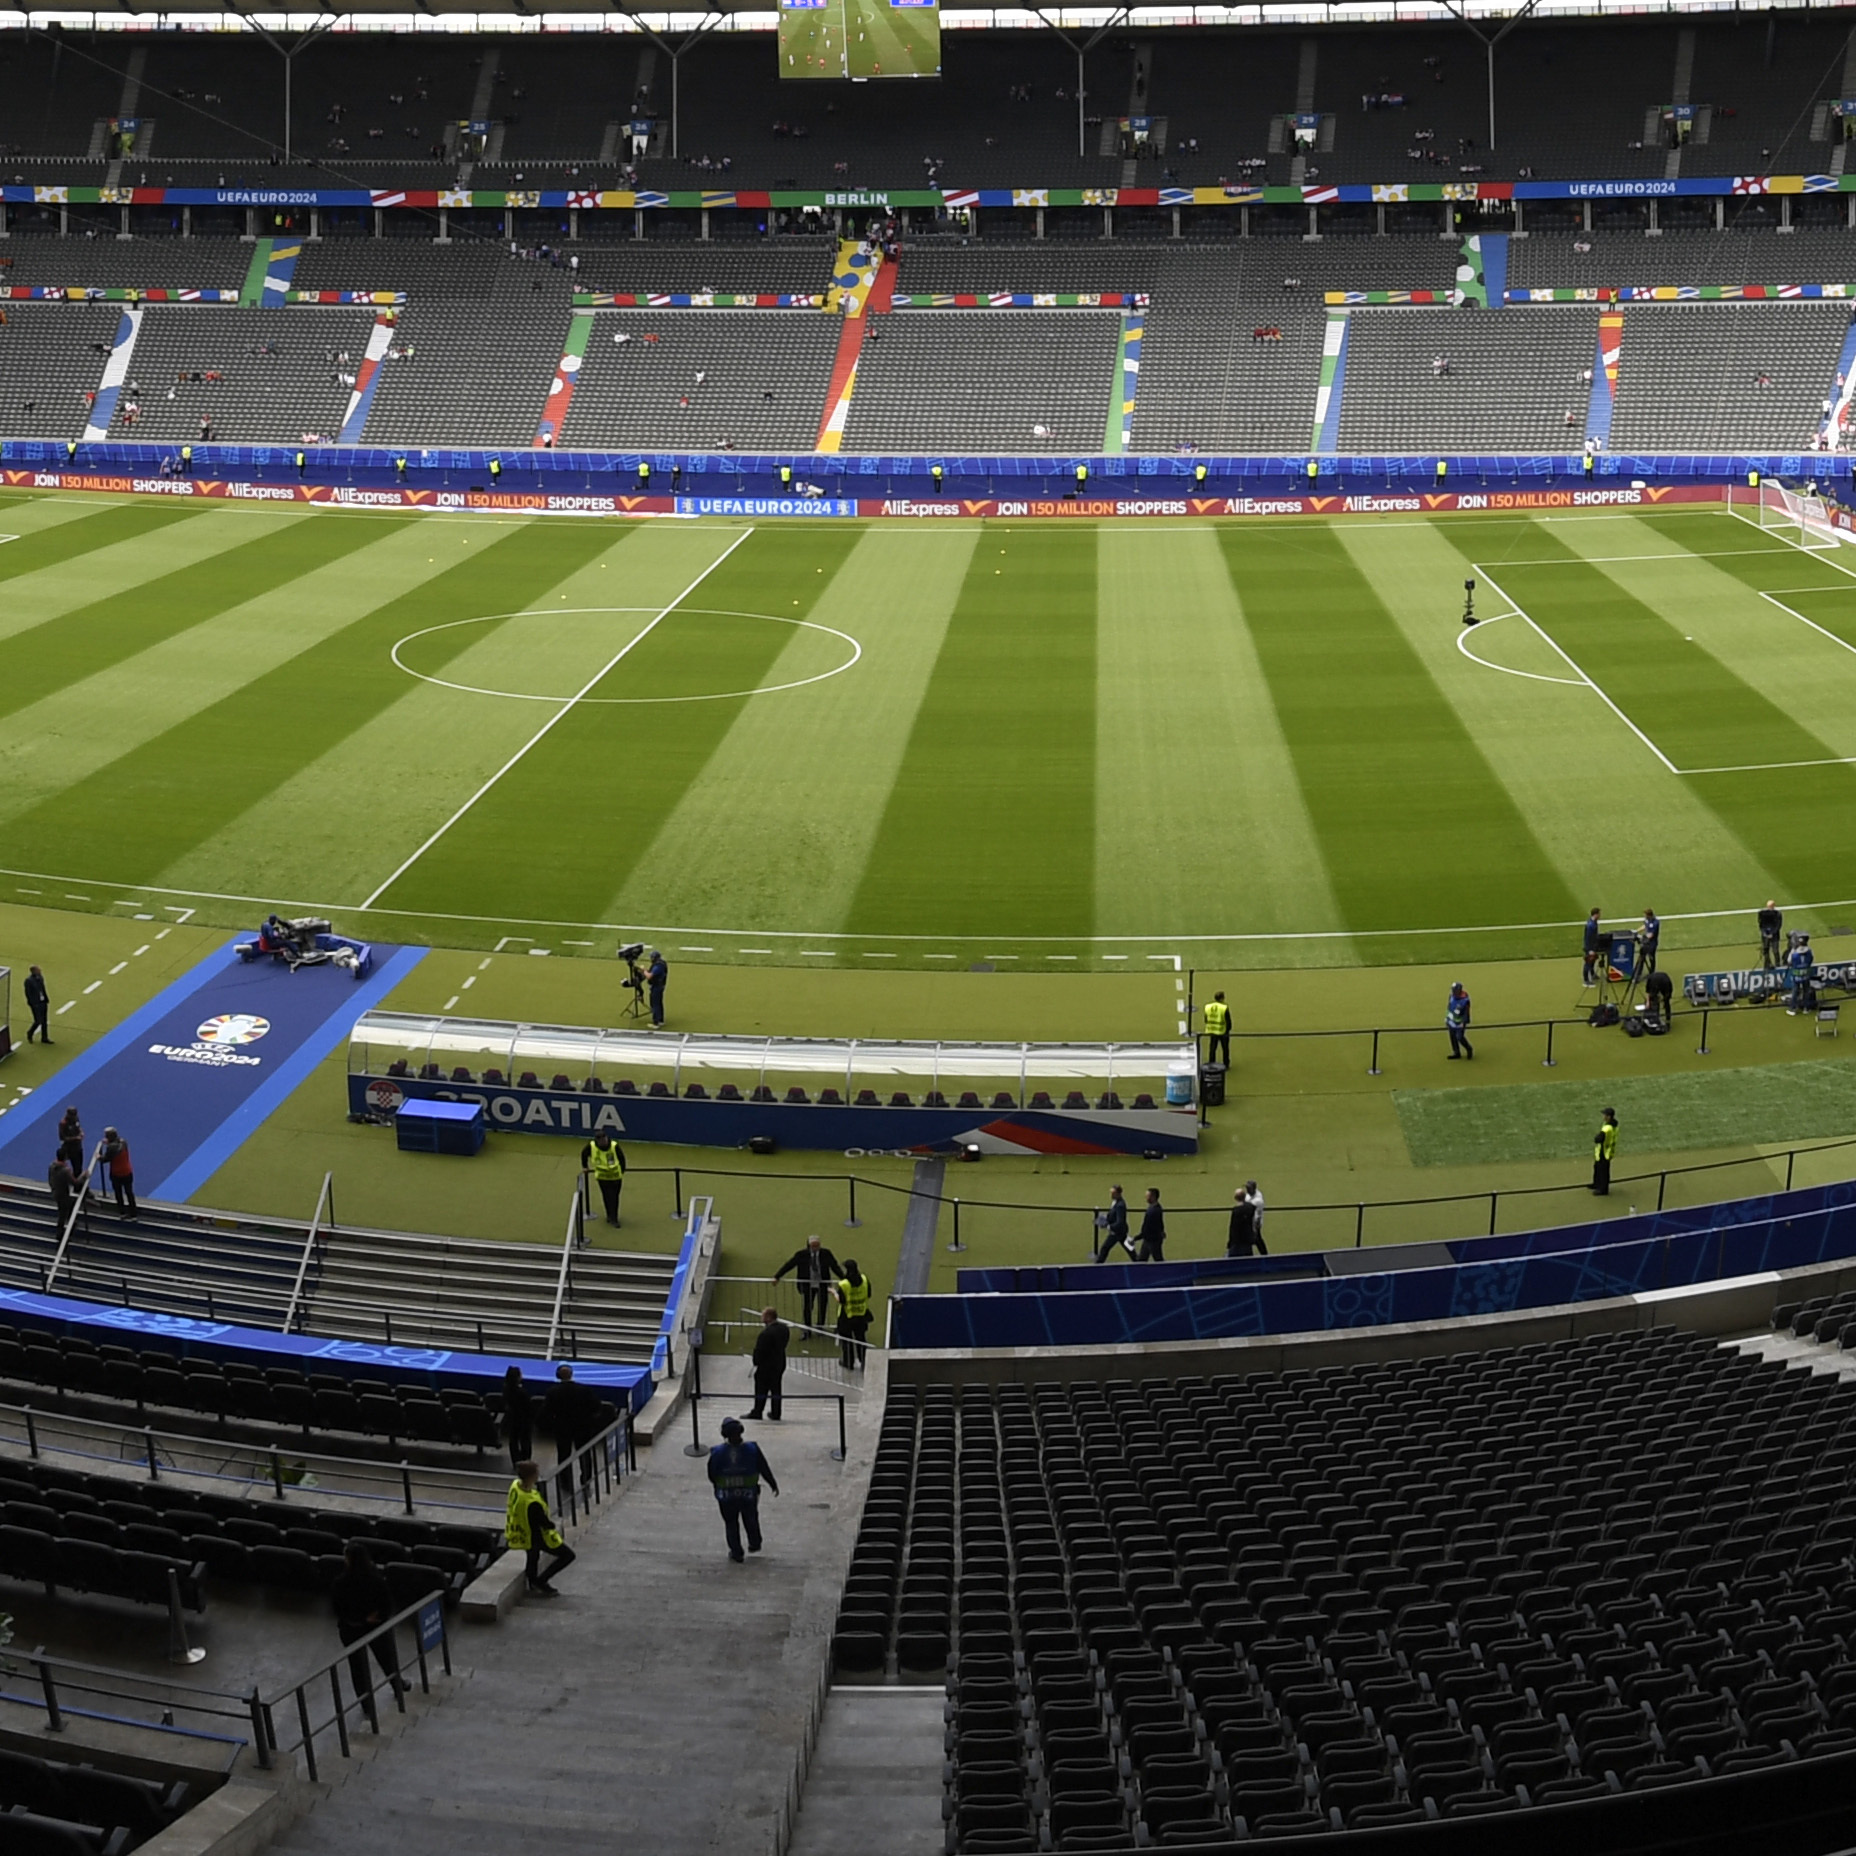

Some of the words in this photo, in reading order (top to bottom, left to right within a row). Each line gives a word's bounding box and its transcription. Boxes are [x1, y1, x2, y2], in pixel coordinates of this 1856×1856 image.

[1677, 107, 1691, 116] 30
[1569, 182, 1676, 195] UEFAEURO2024
[217, 191, 318, 204] UEFAEURO2024
[825, 192, 889, 205] BERLIN
[34, 474, 60, 488] JOIN
[61, 475, 82, 488] 150
[83, 476, 132, 491] MILLION
[132, 478, 194, 494] SHOPPERS
[224, 482, 295, 500] AliExpress
[329, 486, 402, 504] AliExpress
[436, 493, 465, 506] JOIN
[466, 493, 490, 507] 150
[490, 494, 545, 509] MILLION
[546, 495, 616, 510] SHOPPERS
[1456, 495, 1488, 510] JOIN
[1489, 494, 1513, 508] 150
[1514, 492, 1571, 507] MILLION
[1572, 489, 1642, 506] SHOPPERS
[699, 499, 833, 516] UEFAEURO2024
[880, 499, 960, 517] AliExpress
[996, 500, 1028, 517] JOIN
[1030, 501, 1058, 517] 150
[1058, 500, 1115, 517] MILLION
[1116, 500, 1188, 517] SHOPPERS
[1223, 497, 1303, 515] AliExpress
[1342, 494, 1421, 513] AliExpress
[1838, 513, 1852, 529] JOIN
[148, 1044, 262, 1067] EURO2024
[166, 1054, 230, 1068] GERMANY
